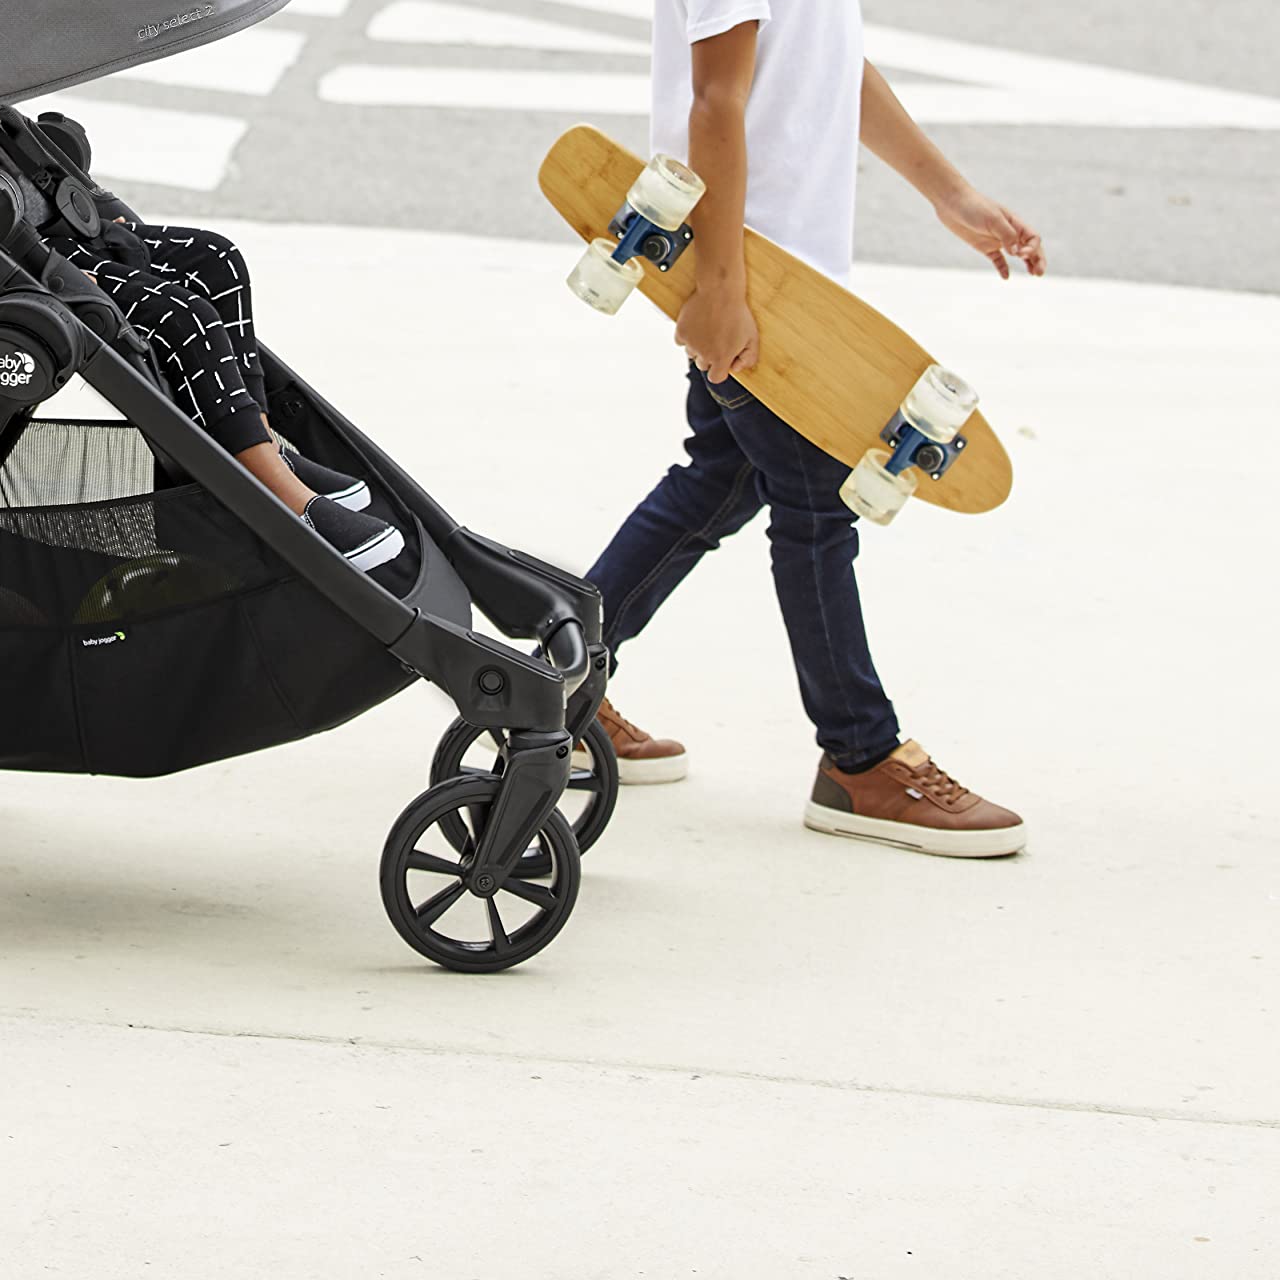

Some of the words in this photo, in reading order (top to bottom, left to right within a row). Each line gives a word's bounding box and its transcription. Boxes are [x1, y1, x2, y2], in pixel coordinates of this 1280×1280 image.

[137, 24, 161, 40] city
[163, 8, 202, 30] select
[205, 5, 215, 16] 2
